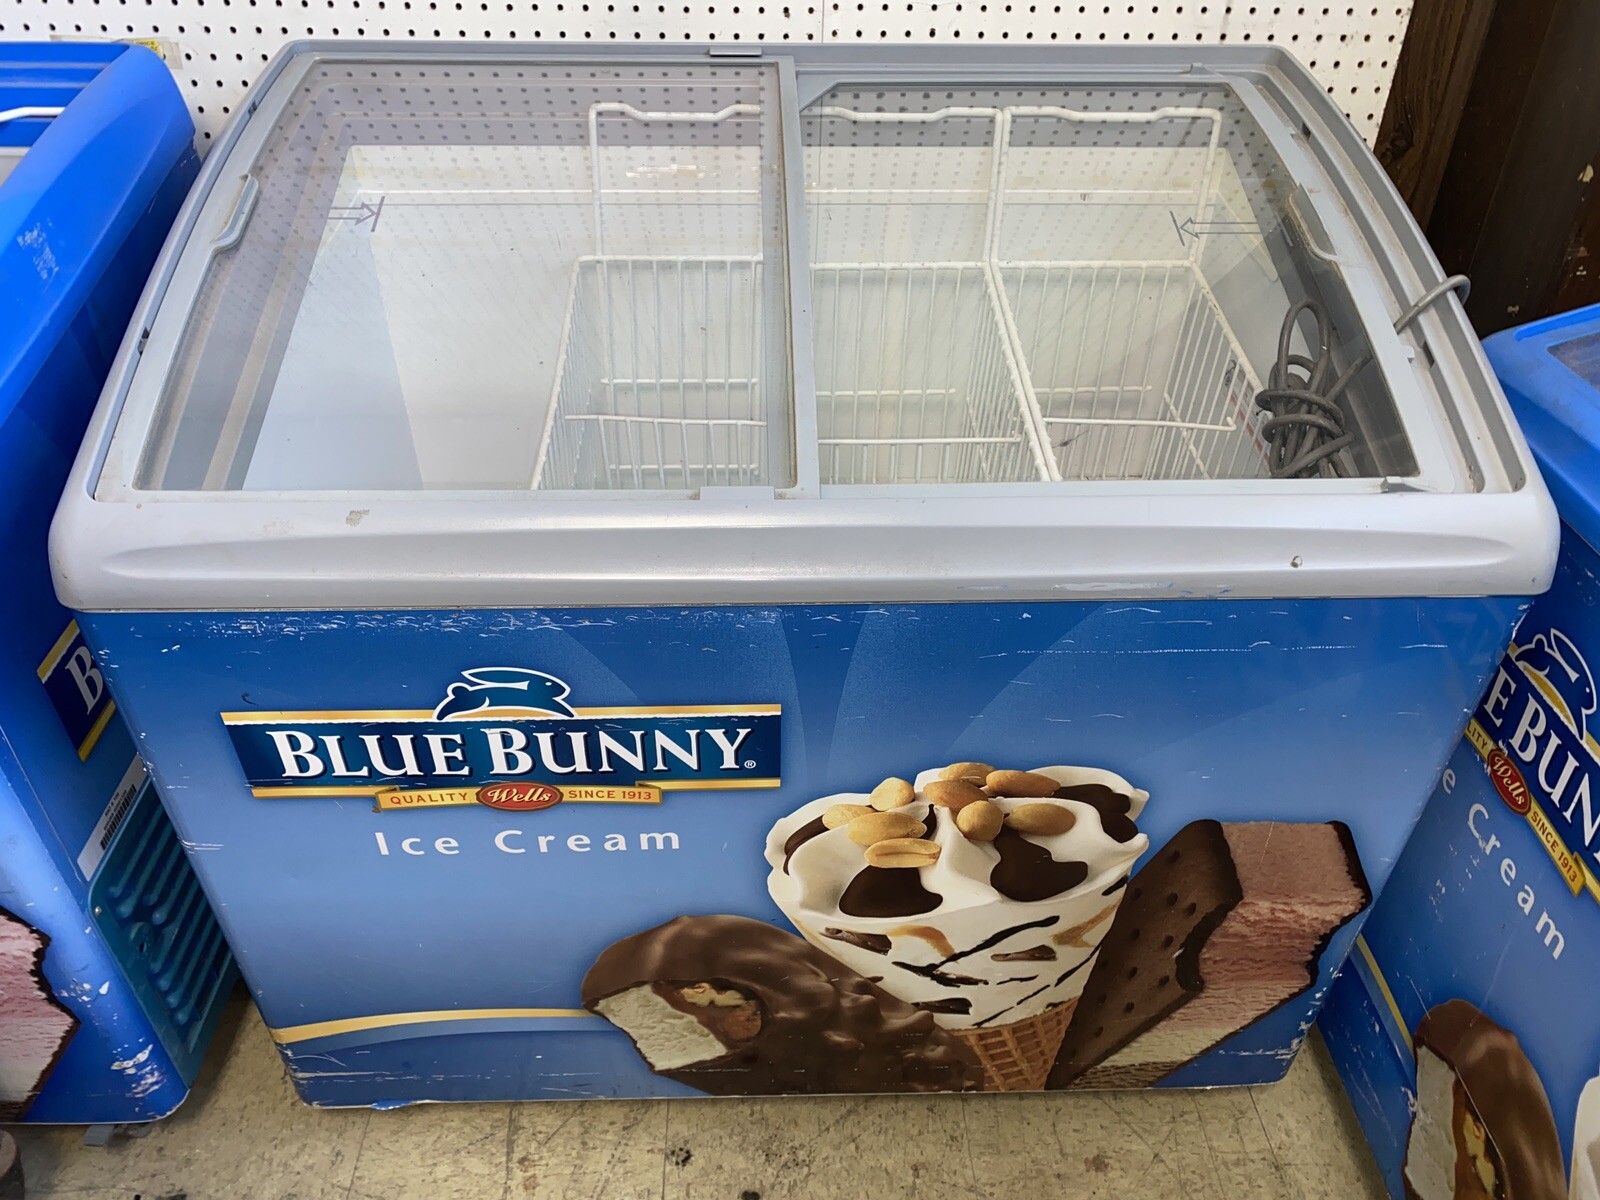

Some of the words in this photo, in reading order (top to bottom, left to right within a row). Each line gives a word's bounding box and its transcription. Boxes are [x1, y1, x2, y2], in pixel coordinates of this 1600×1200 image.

[265, 730, 471, 778] BLUE
[390, 791, 468, 805] QUALITY
[486, 787, 553, 804] Wells
[568, 789, 616, 800] SINCE
[621, 790, 652, 801] 1913
[1509, 693, 1600, 866] BUN
[374, 831, 460, 856] Ice
[494, 829, 680, 854] Cream
[1491, 755, 1525, 806] Wells
[1530, 811, 1559, 852] SINCE
[1557, 851, 1578, 883] 1913
[1467, 803, 1565, 960] Cream
